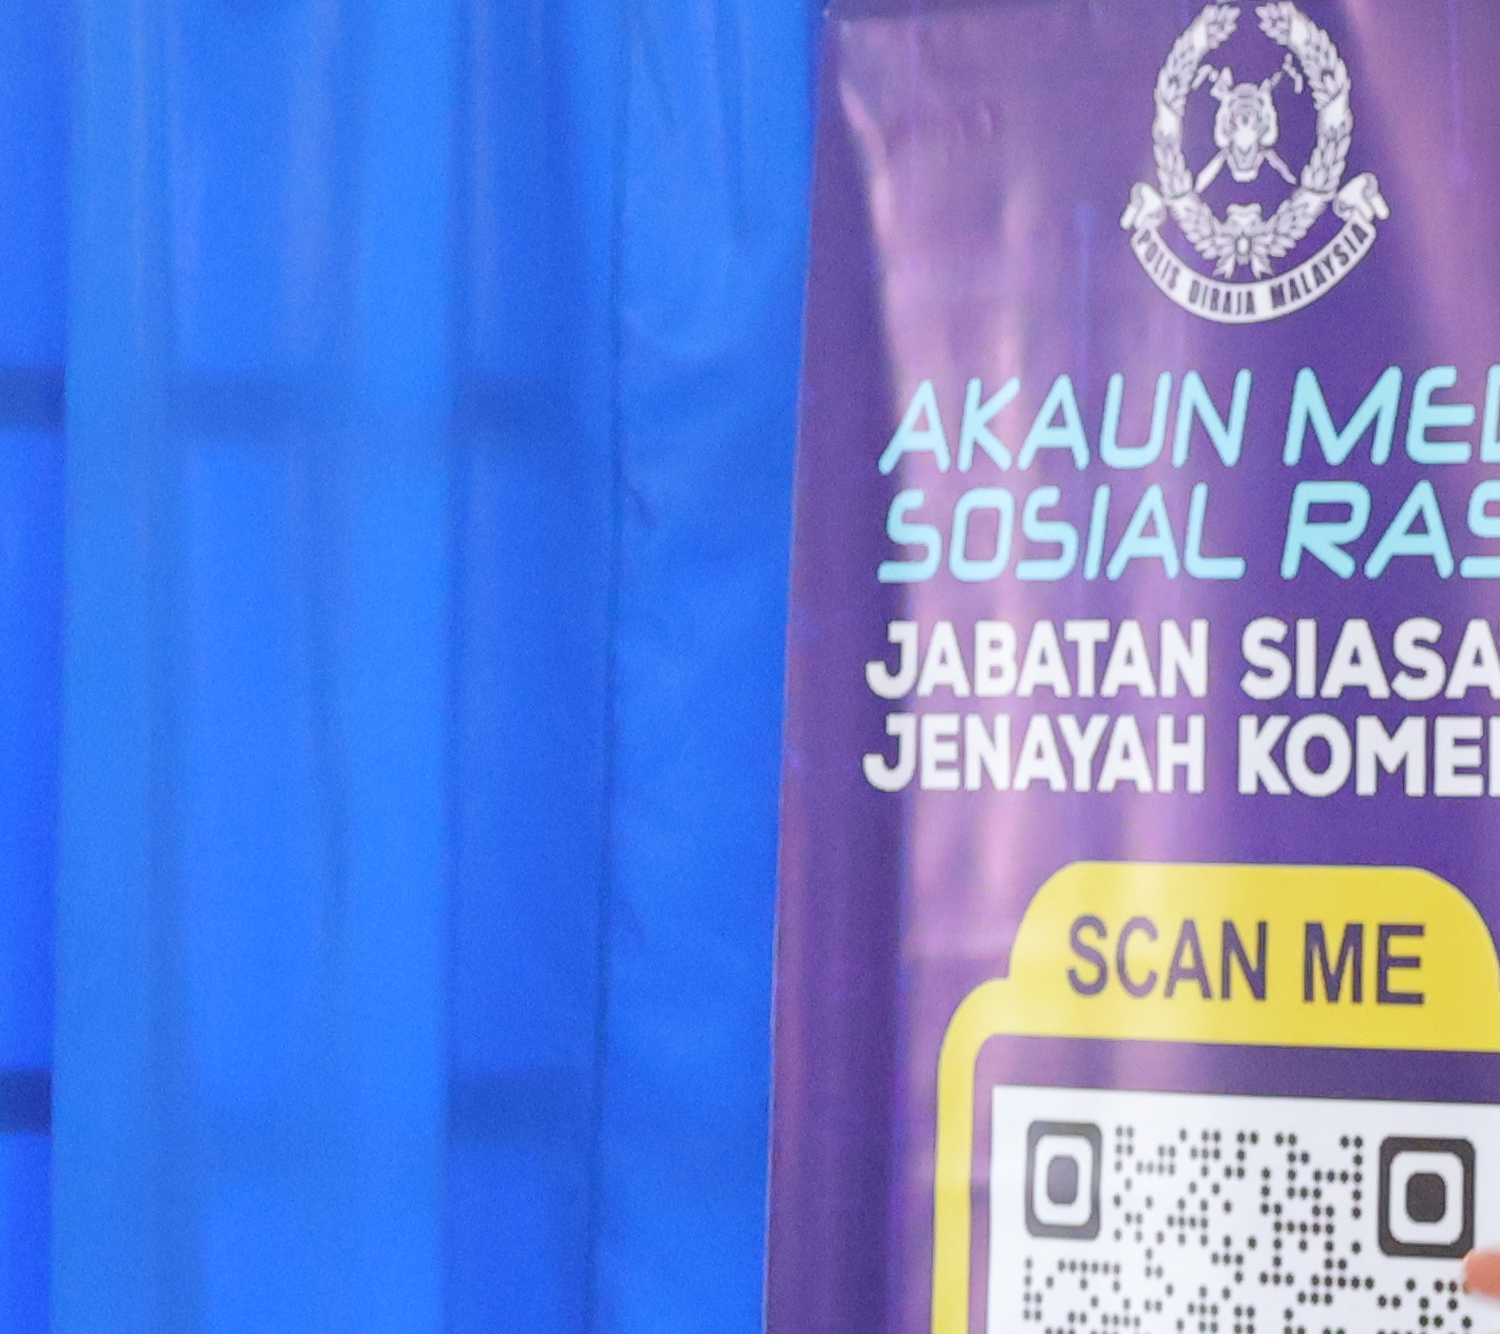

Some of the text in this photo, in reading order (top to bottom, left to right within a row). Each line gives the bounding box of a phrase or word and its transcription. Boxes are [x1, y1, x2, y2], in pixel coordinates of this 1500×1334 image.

[1137, 223, 1369, 315] POLIS DIRAJA MALAYSIA
[879, 369, 1250, 472] AKAUN
[877, 483, 1245, 582] SOSIAL
[864, 619, 1208, 699] JABATAN
[862, 714, 1204, 795] JENAYAH
[1068, 915, 1425, 1006] SCAN ME
